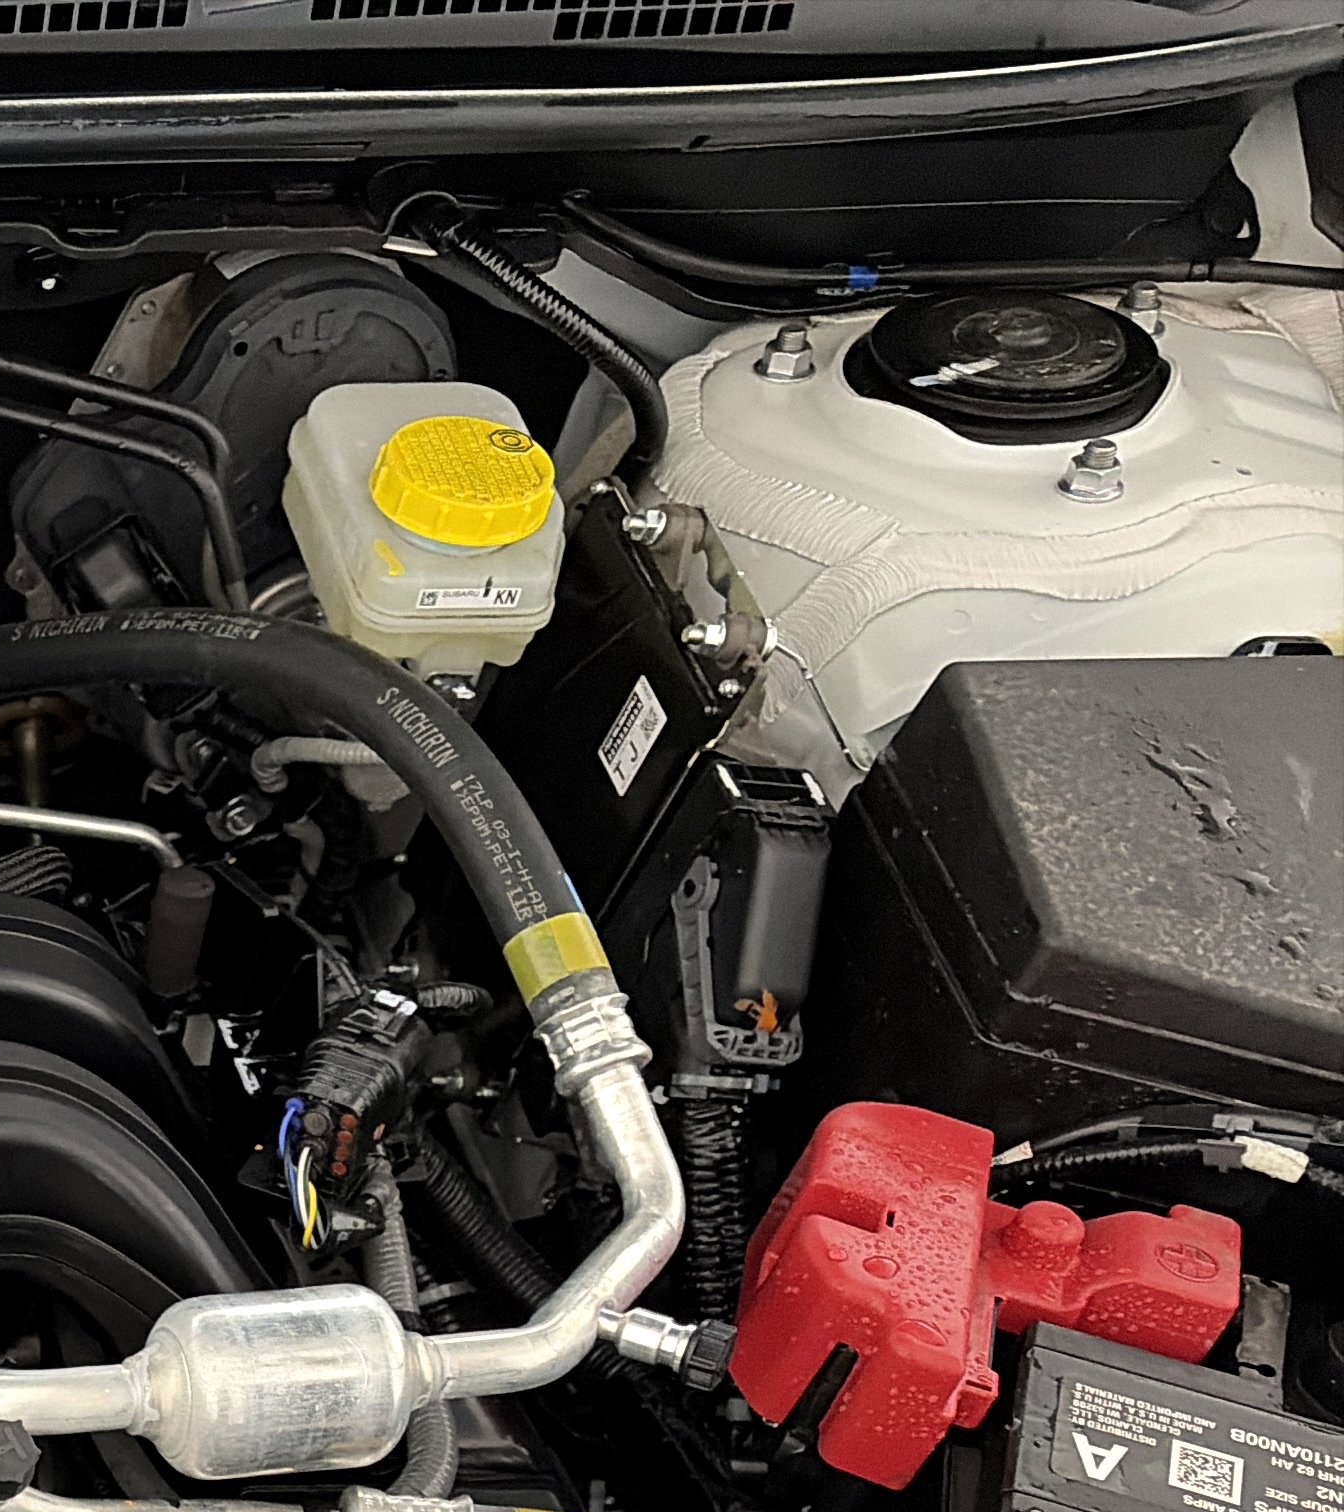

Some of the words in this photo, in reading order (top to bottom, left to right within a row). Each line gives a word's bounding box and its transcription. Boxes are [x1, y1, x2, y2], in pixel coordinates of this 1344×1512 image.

[442, 590, 480, 598] SUBARU
[493, 589, 519, 605] KN
[27, 616, 108, 641] NICHIRIN
[389, 697, 463, 769] NICHIRIN
[463, 774, 494, 811] 17LP
[1075, 1382, 1136, 1406] MATERIALS
[1093, 1397, 1123, 1411] WITH
[1136, 1399, 1192, 1422] IMPORTED
[1106, 1408, 1121, 1419] WI
[1158, 1415, 1170, 1425] IN
[1172, 1419, 1204, 1434] MADE
[1193, 1416, 1216, 1429] AND
[1087, 1420, 1157, 1446] DISTRIBUTED
[1270, 1456, 1294, 1471] AH
[1296, 1463, 1315, 1477] 62
[1264, 1486, 1298, 1505] SIZE
